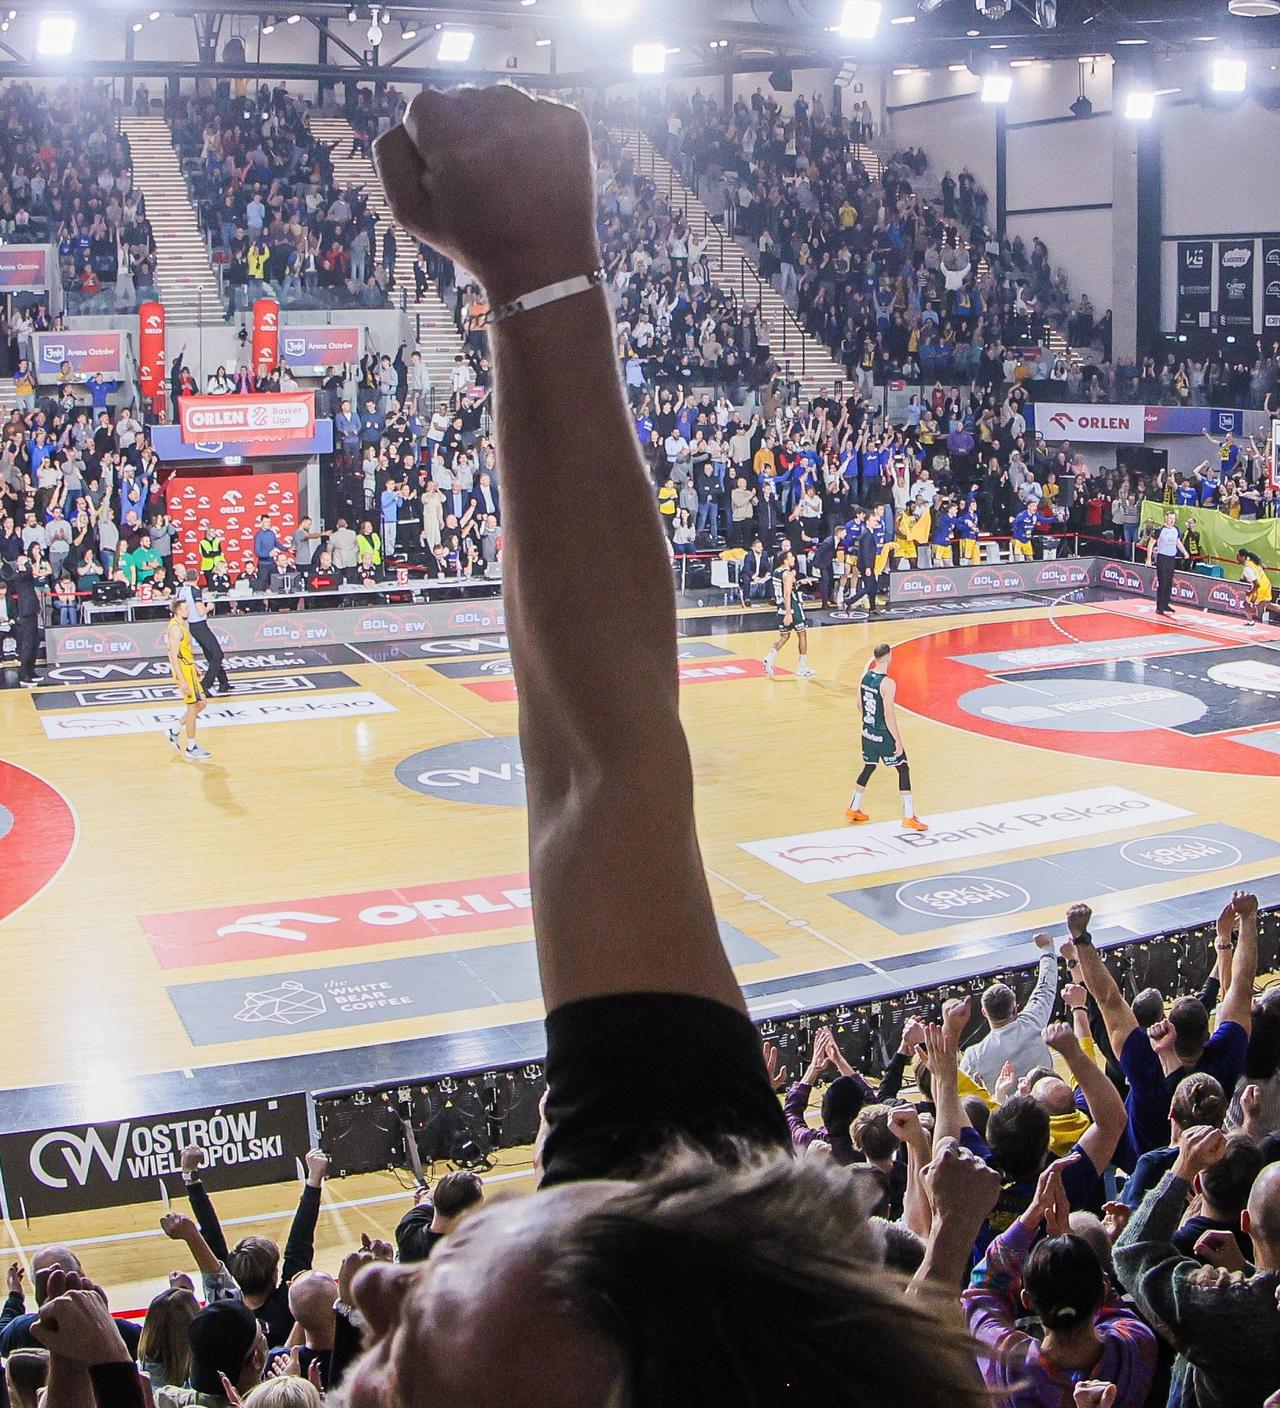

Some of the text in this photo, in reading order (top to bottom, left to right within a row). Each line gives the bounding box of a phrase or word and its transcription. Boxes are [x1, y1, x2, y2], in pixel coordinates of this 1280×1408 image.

[67, 349, 88, 357] Arena
[308, 342, 328, 350] Arena
[192, 407, 302, 426] ORLEN Basket
[272, 416, 291, 426] Liga
[1077, 415, 1131, 431] ORLEN
[219, 505, 246, 515] ORLEN
[141, 586, 153, 599] 5
[258, 698, 376, 717] Pekao
[892, 796, 1152, 854] Bank Pekao
[1138, 838, 1210, 860] KOKU
[1154, 845, 1225, 867] SUSHI
[914, 881, 996, 903] KOKU
[930, 889, 1012, 911] SUSHI
[332, 980, 393, 997] WHITE
[333, 990, 387, 1005] BEAR
[339, 996, 414, 1013] COFFEE
[131, 1108, 258, 1157] OSTRÓW
[127, 1134, 284, 1181] WIELOPOLSKI
